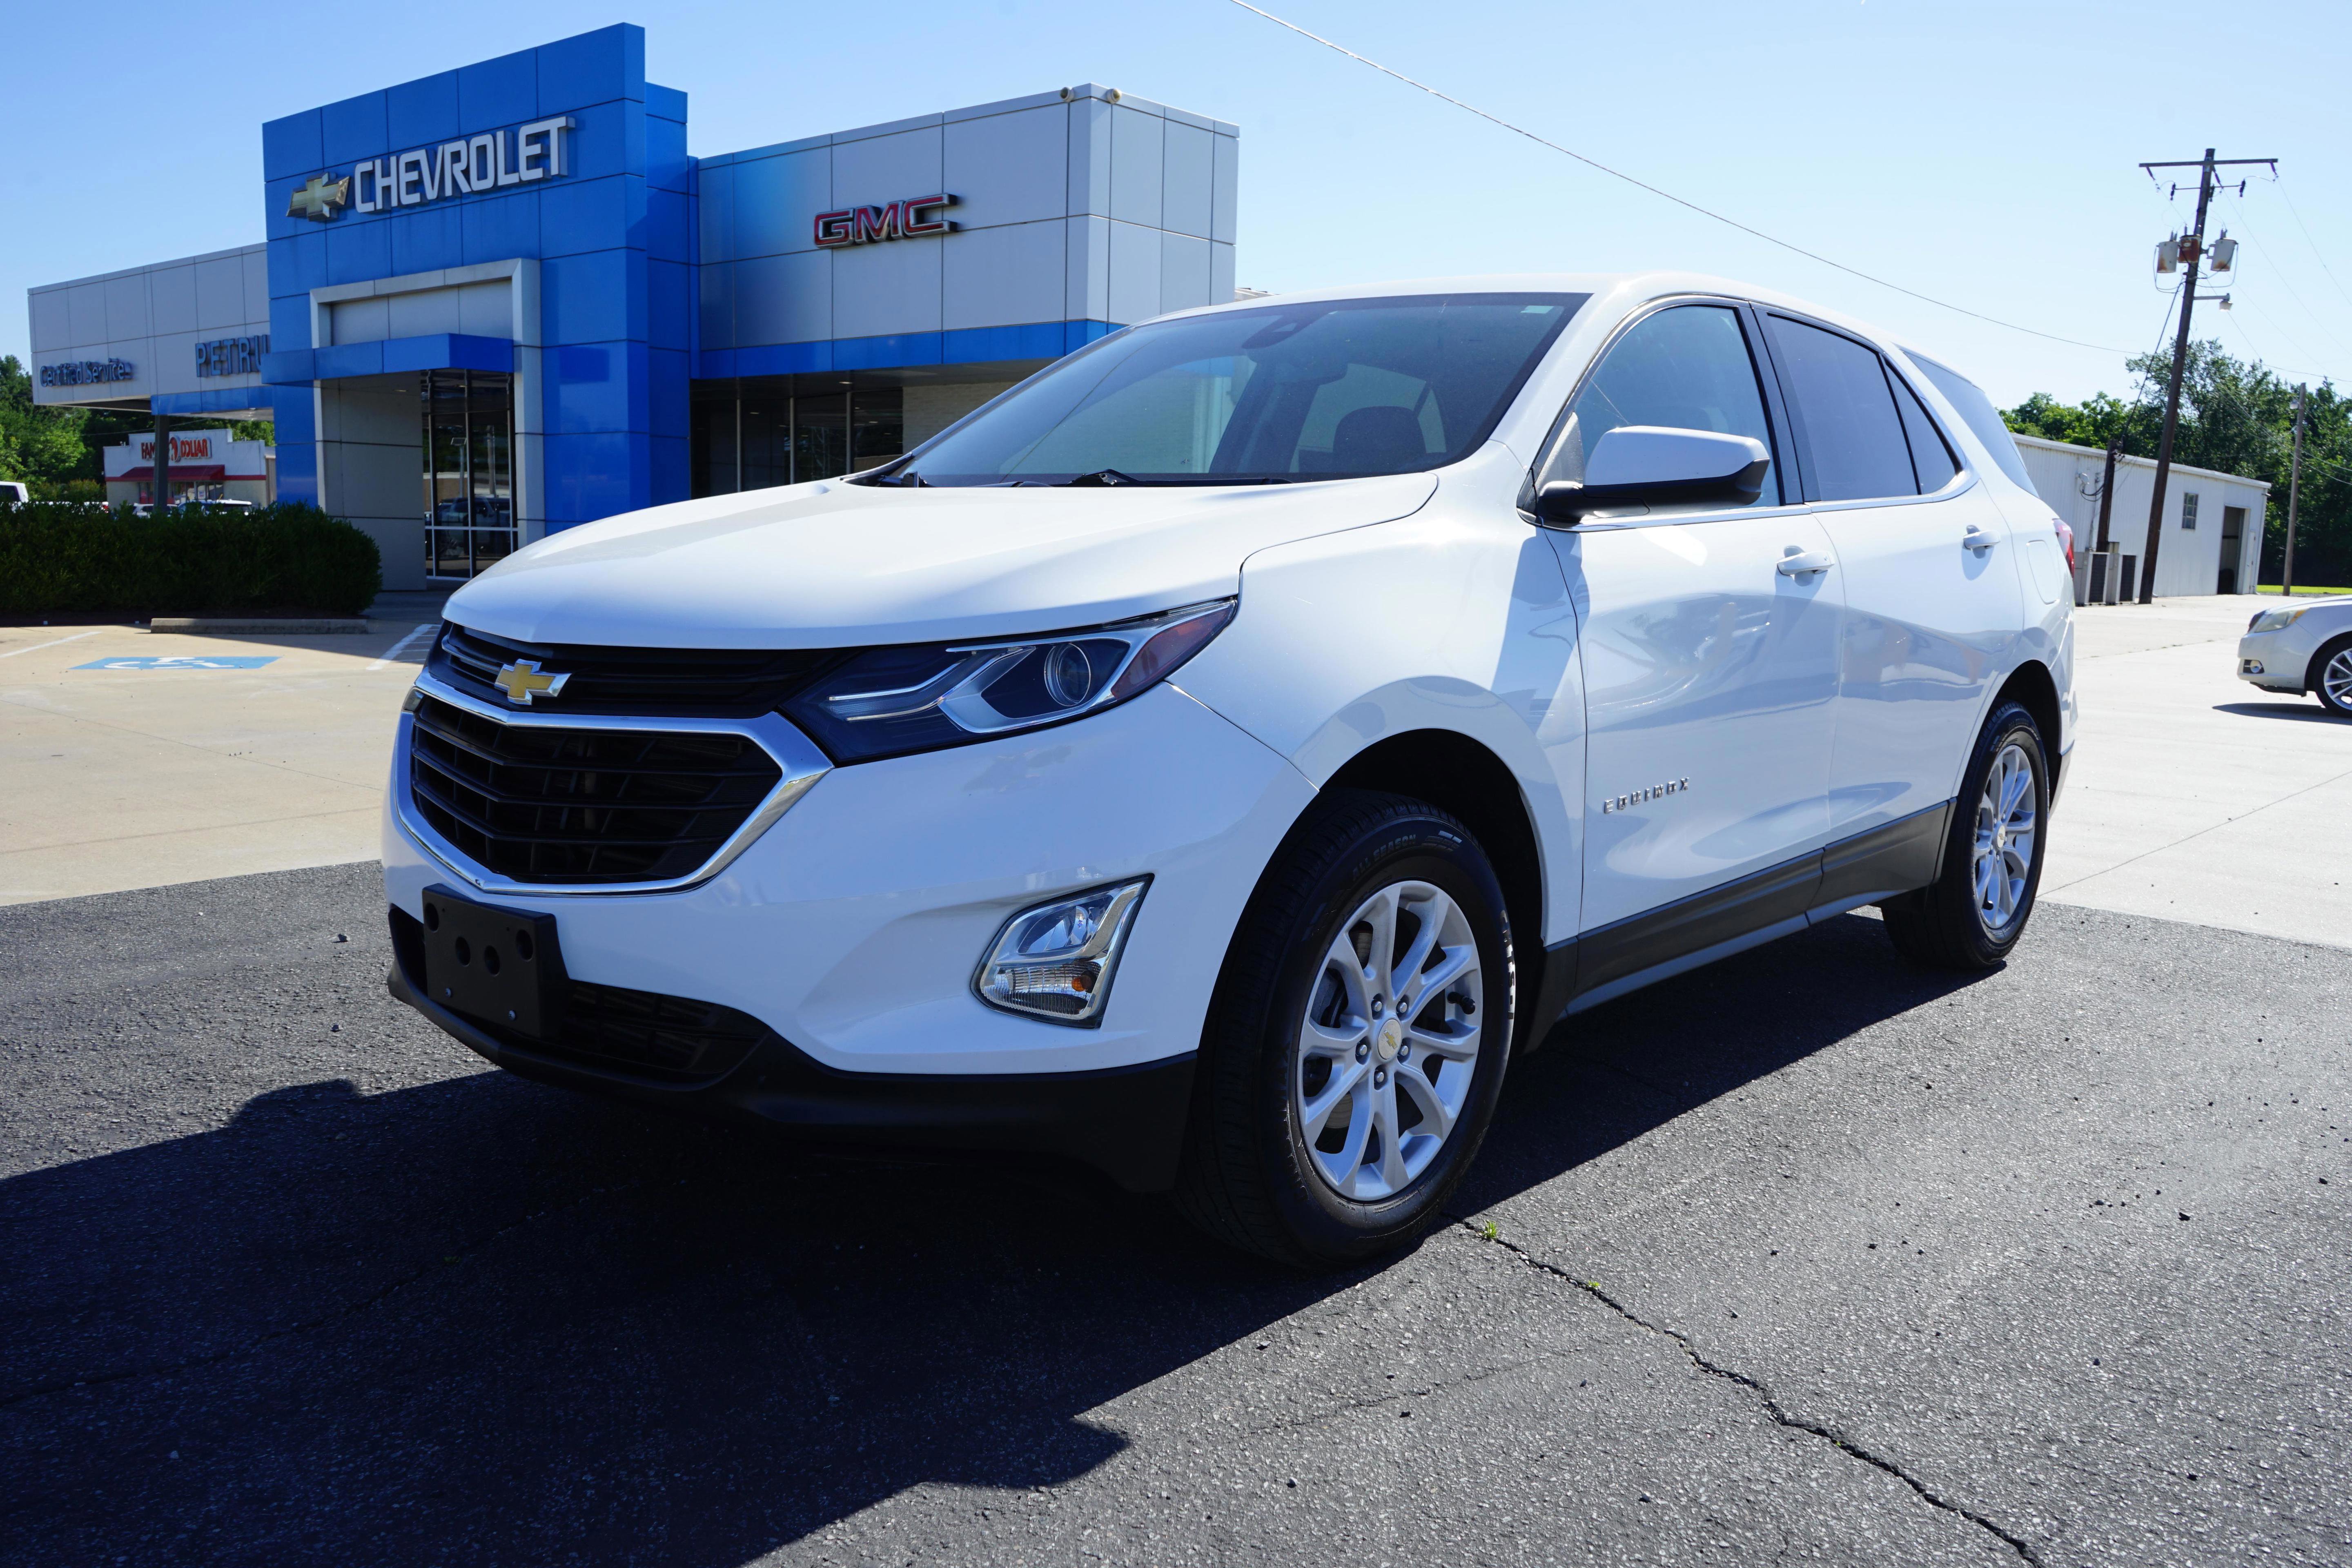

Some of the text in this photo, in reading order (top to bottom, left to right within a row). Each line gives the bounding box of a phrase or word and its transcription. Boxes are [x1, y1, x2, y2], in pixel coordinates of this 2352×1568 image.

[354, 116, 570, 213] CHEVROLET
[814, 193, 951, 249] GMC
[40, 358, 126, 387] Certified Service
[180, 438, 209, 458] DOLLAR
[1604, 777, 1690, 814] EQUINOX
[1373, 834, 1417, 862] SEASON
